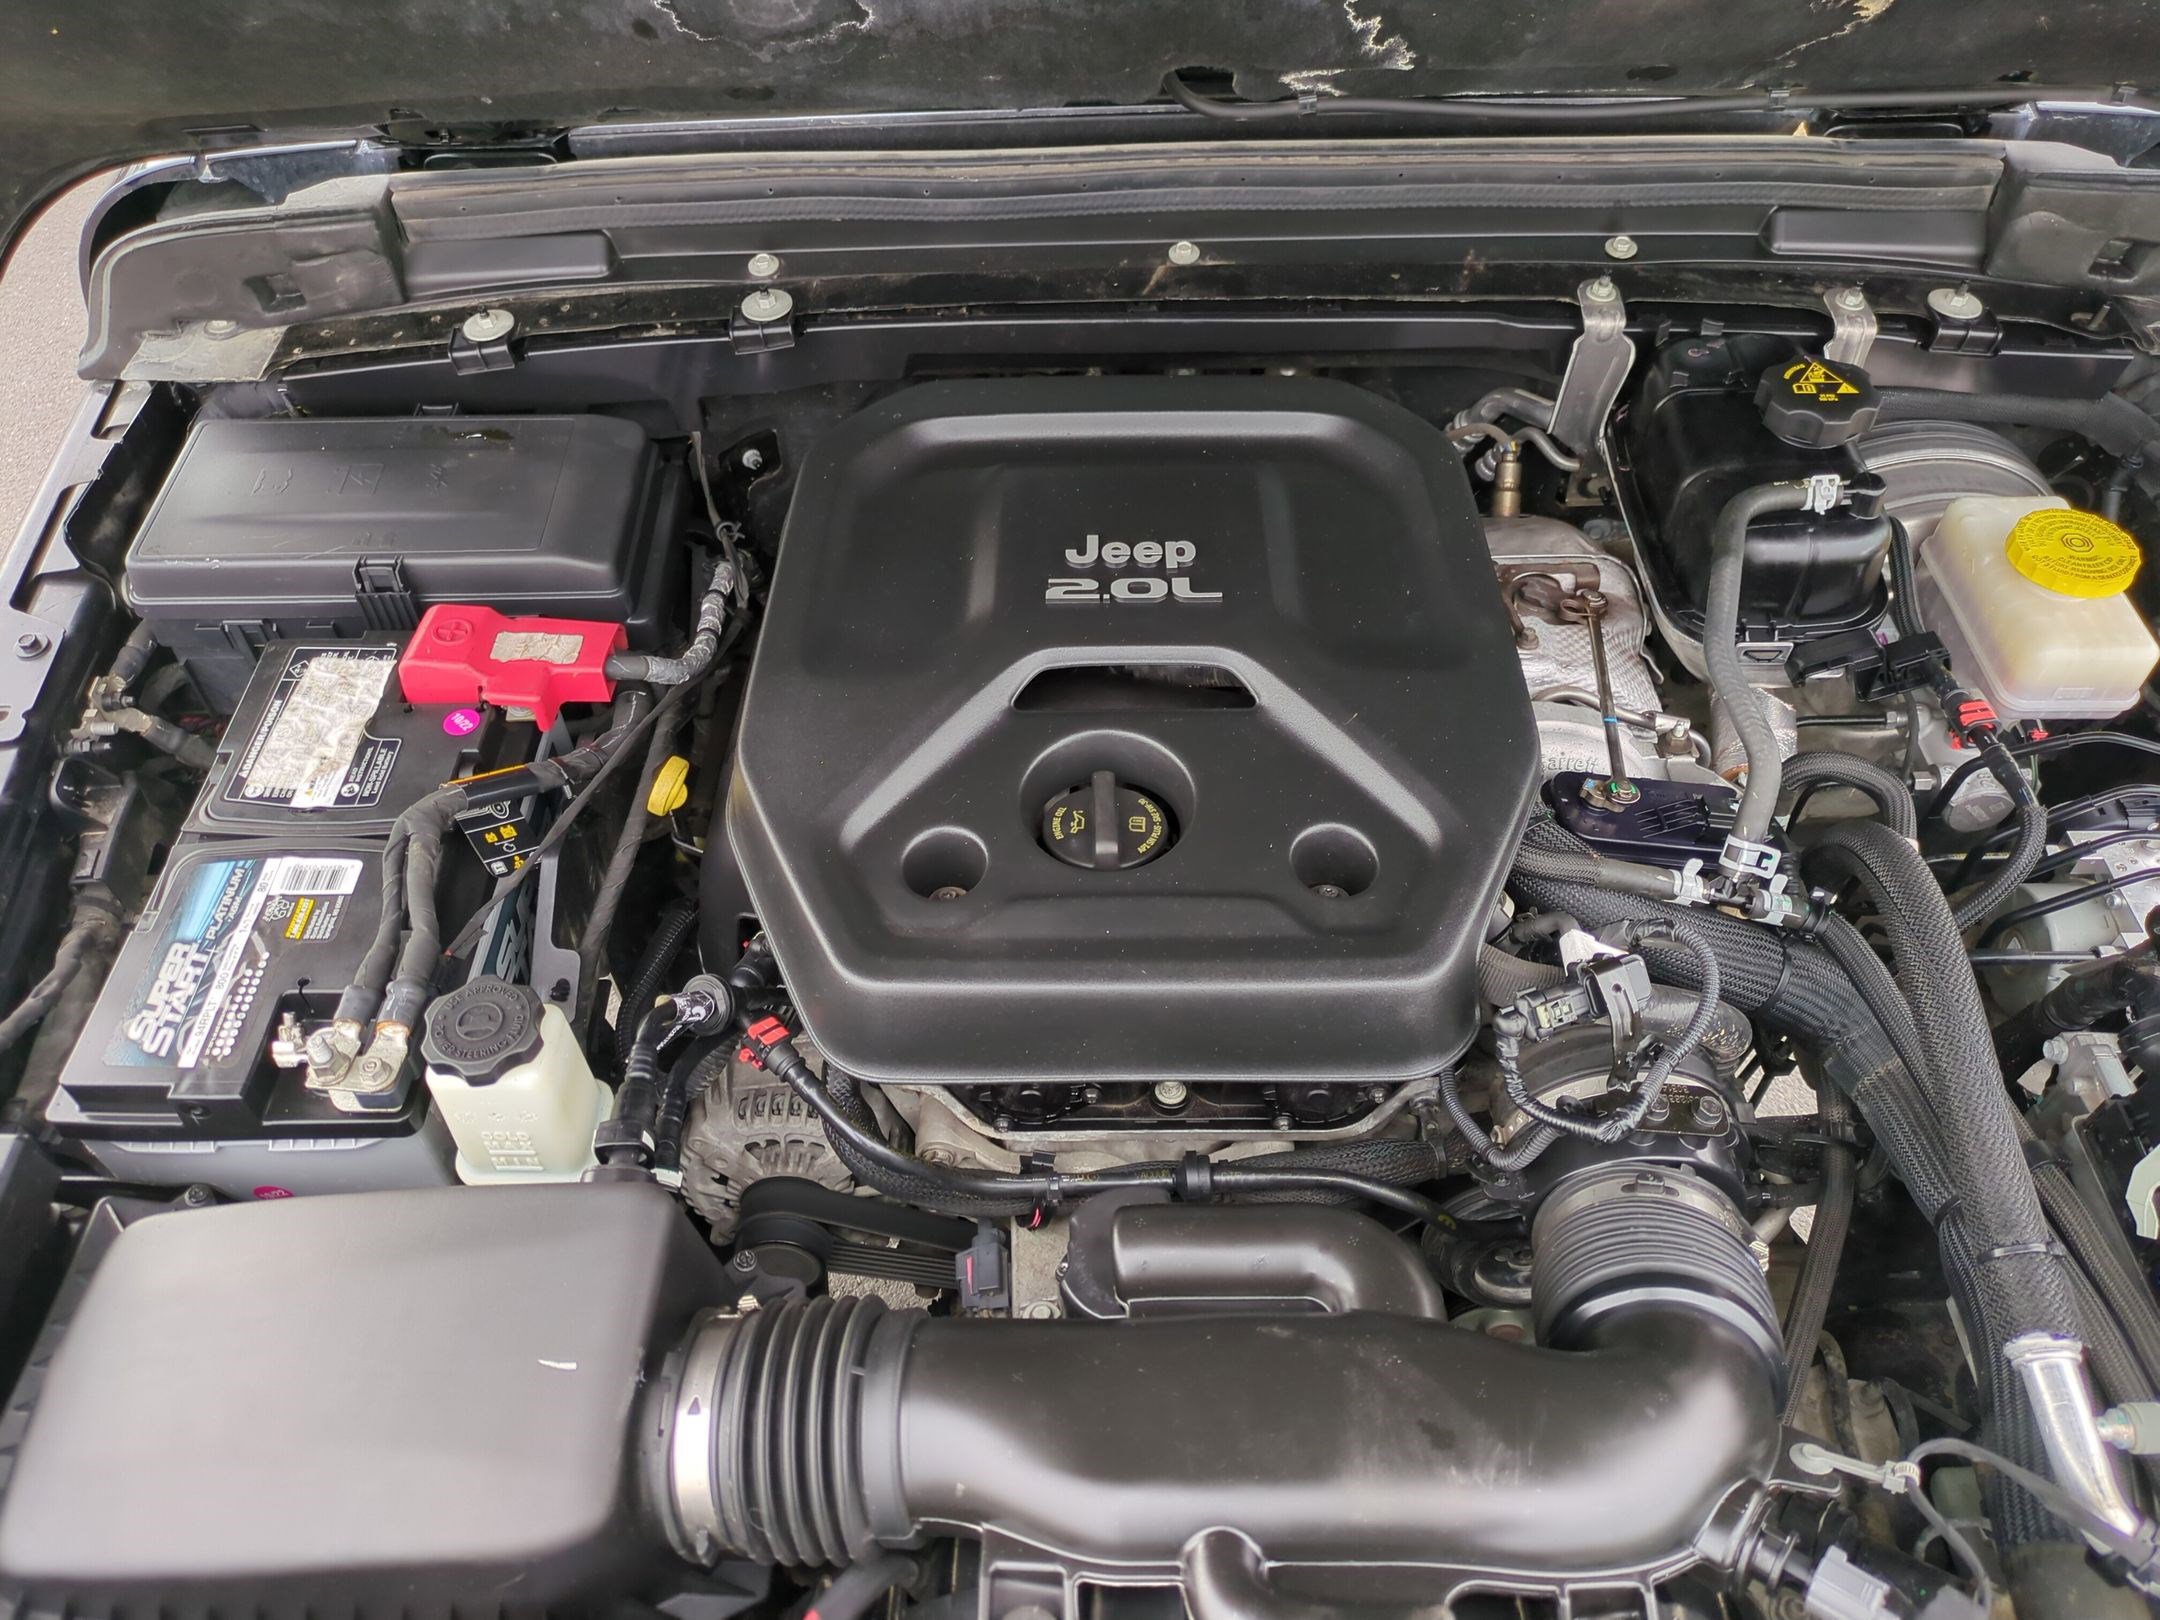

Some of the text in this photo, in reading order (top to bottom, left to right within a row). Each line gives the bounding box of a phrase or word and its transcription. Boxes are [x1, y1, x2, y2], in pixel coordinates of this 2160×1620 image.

[1065, 534, 1196, 571] Jeep
[1046, 577, 1223, 602] 2.0L
[1052, 807, 1067, 840] ENGINE OIL
[205, 867, 246, 940] PLATINUM
[127, 942, 192, 1041] SUPER
[143, 942, 212, 1057] START
[443, 984, 519, 1011] USE APPROVED
[454, 1040, 510, 1058] STEERING
[505, 1014, 524, 1041] FLUID
[481, 1131, 530, 1142] COLD
